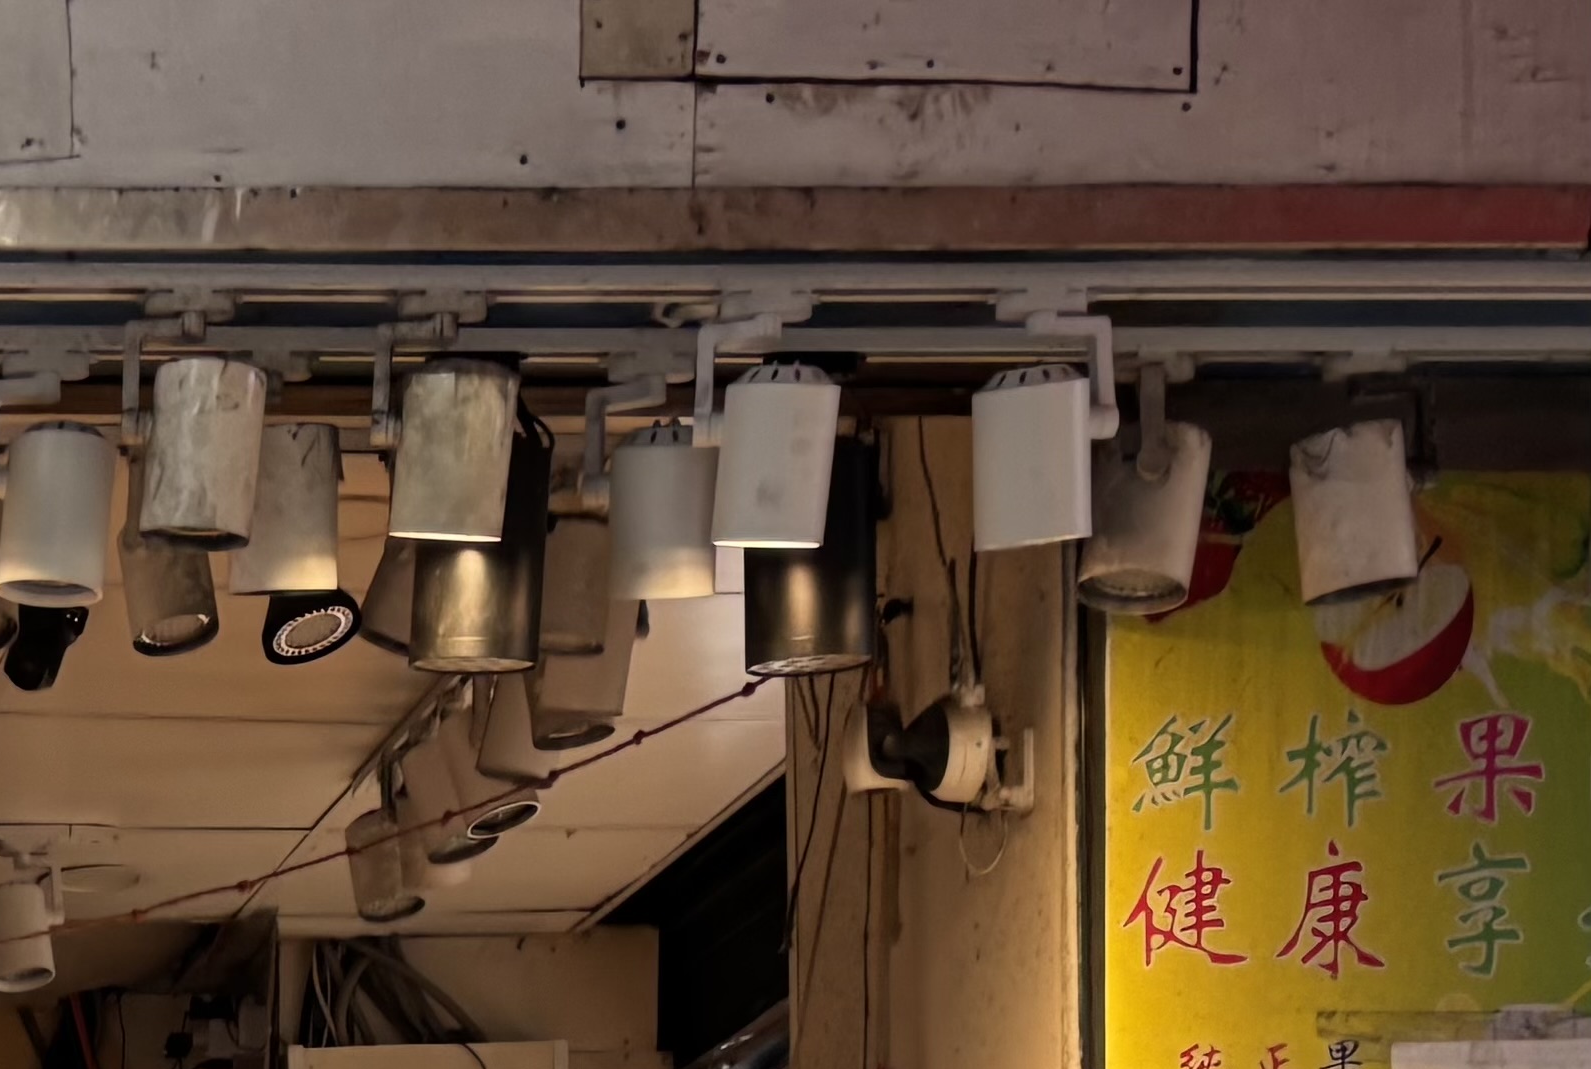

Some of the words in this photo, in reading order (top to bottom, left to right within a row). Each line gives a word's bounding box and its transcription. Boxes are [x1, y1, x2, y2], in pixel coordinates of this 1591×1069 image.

[1131, 708, 1545, 830] 鮮榨果
[1122, 839, 1591, 979] 健康享
